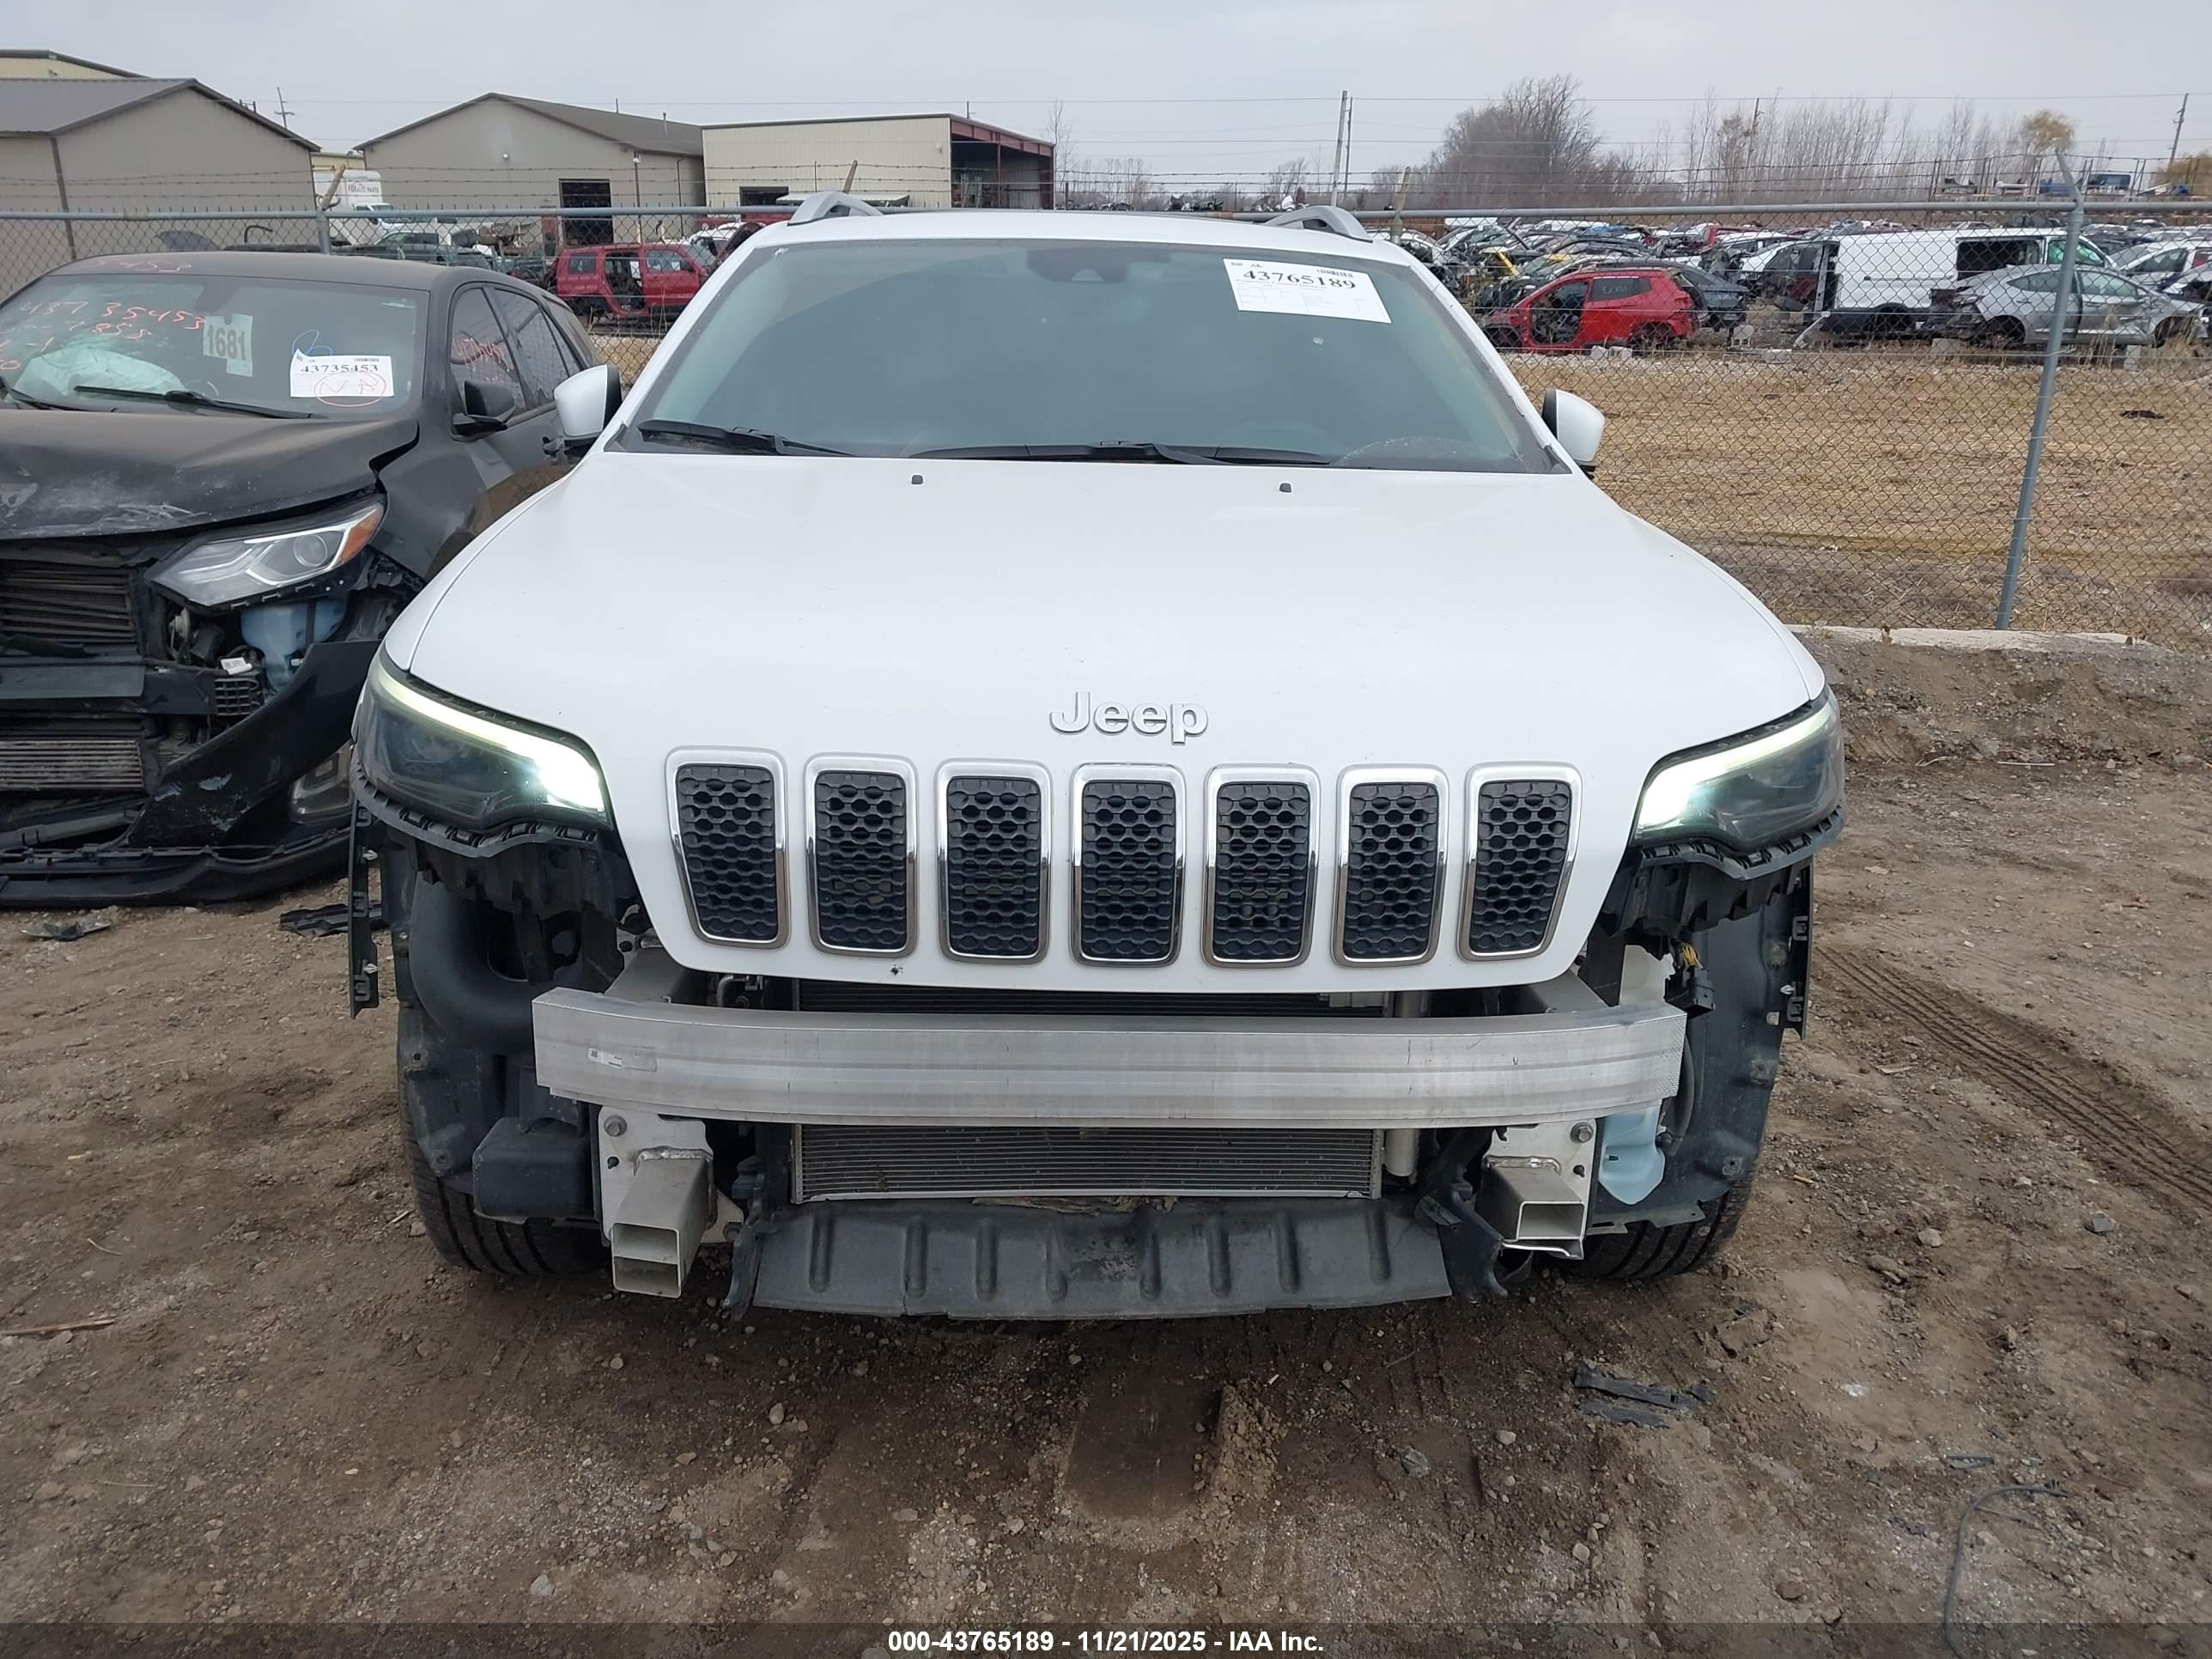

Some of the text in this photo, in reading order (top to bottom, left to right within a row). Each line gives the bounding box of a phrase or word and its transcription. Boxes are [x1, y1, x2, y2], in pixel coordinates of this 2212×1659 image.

[1243, 270, 1357, 289] 43765189
[206, 324, 247, 362] 1681
[301, 364, 379, 373] 43735453
[1049, 690, 1209, 746] Jeep
